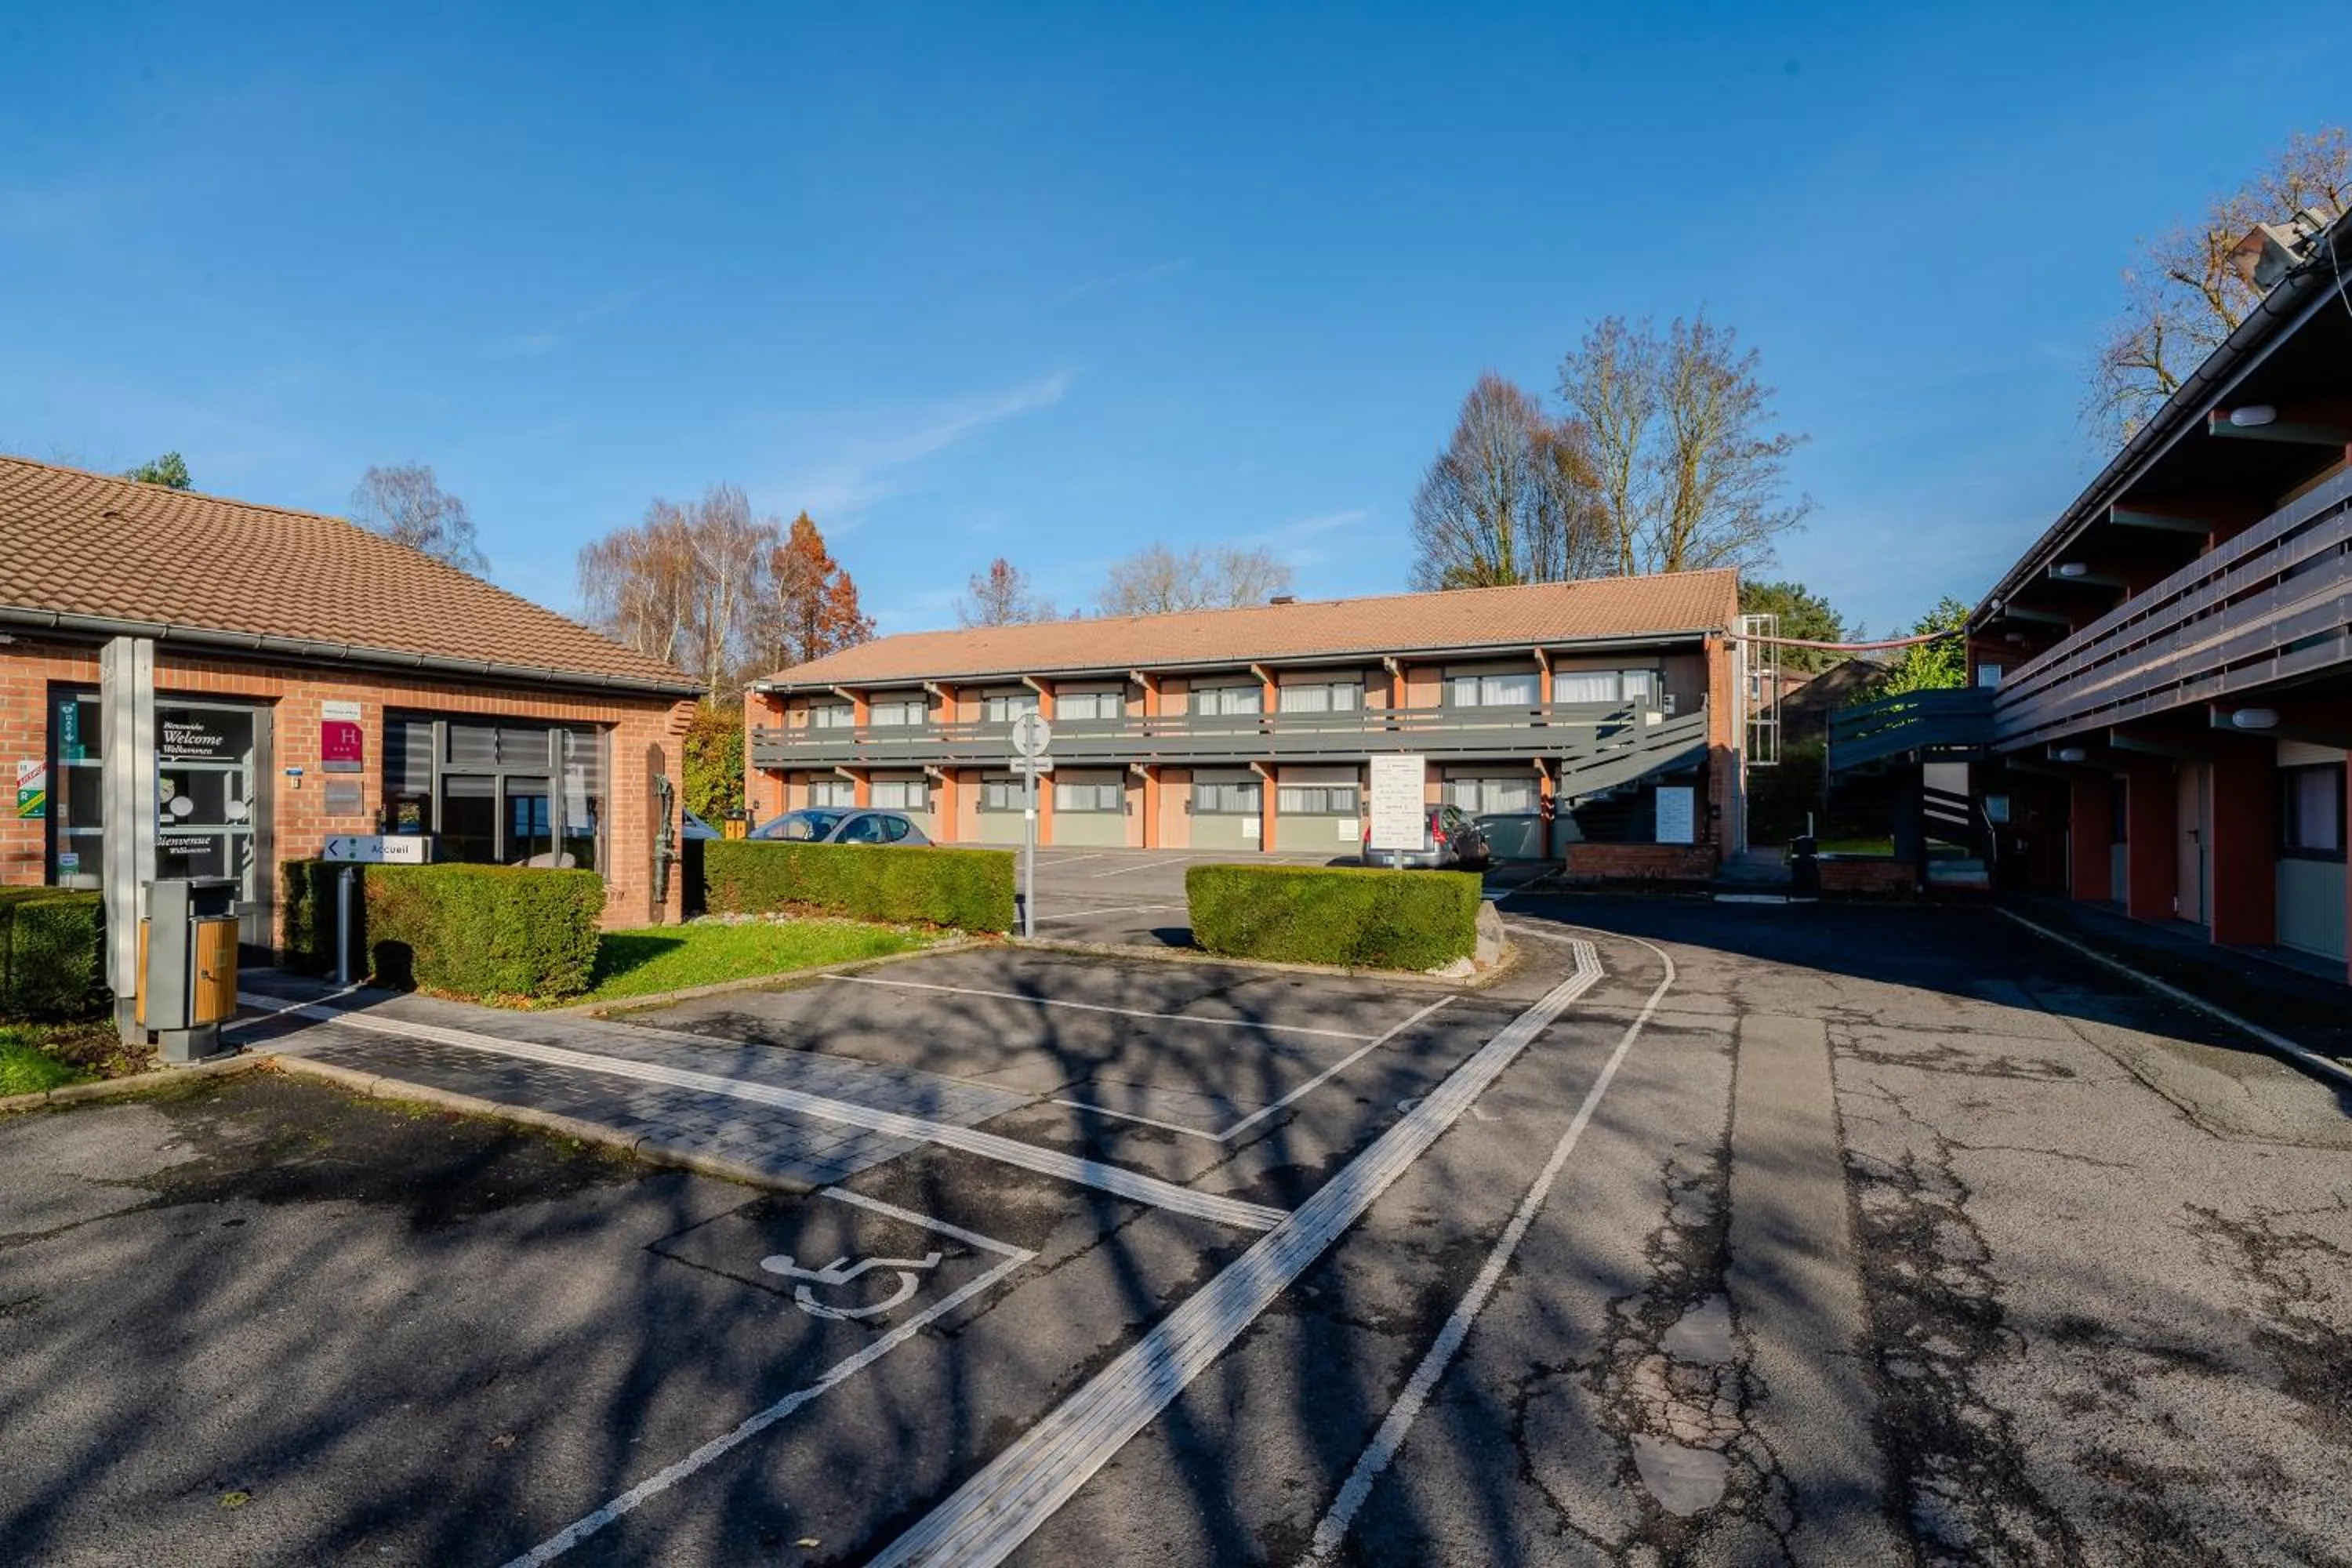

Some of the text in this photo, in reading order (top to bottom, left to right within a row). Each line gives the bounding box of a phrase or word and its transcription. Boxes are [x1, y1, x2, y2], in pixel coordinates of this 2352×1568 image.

[163, 731, 223, 746] Welcome
[341, 728, 358, 745] H
[371, 844, 409, 854] Accueil
